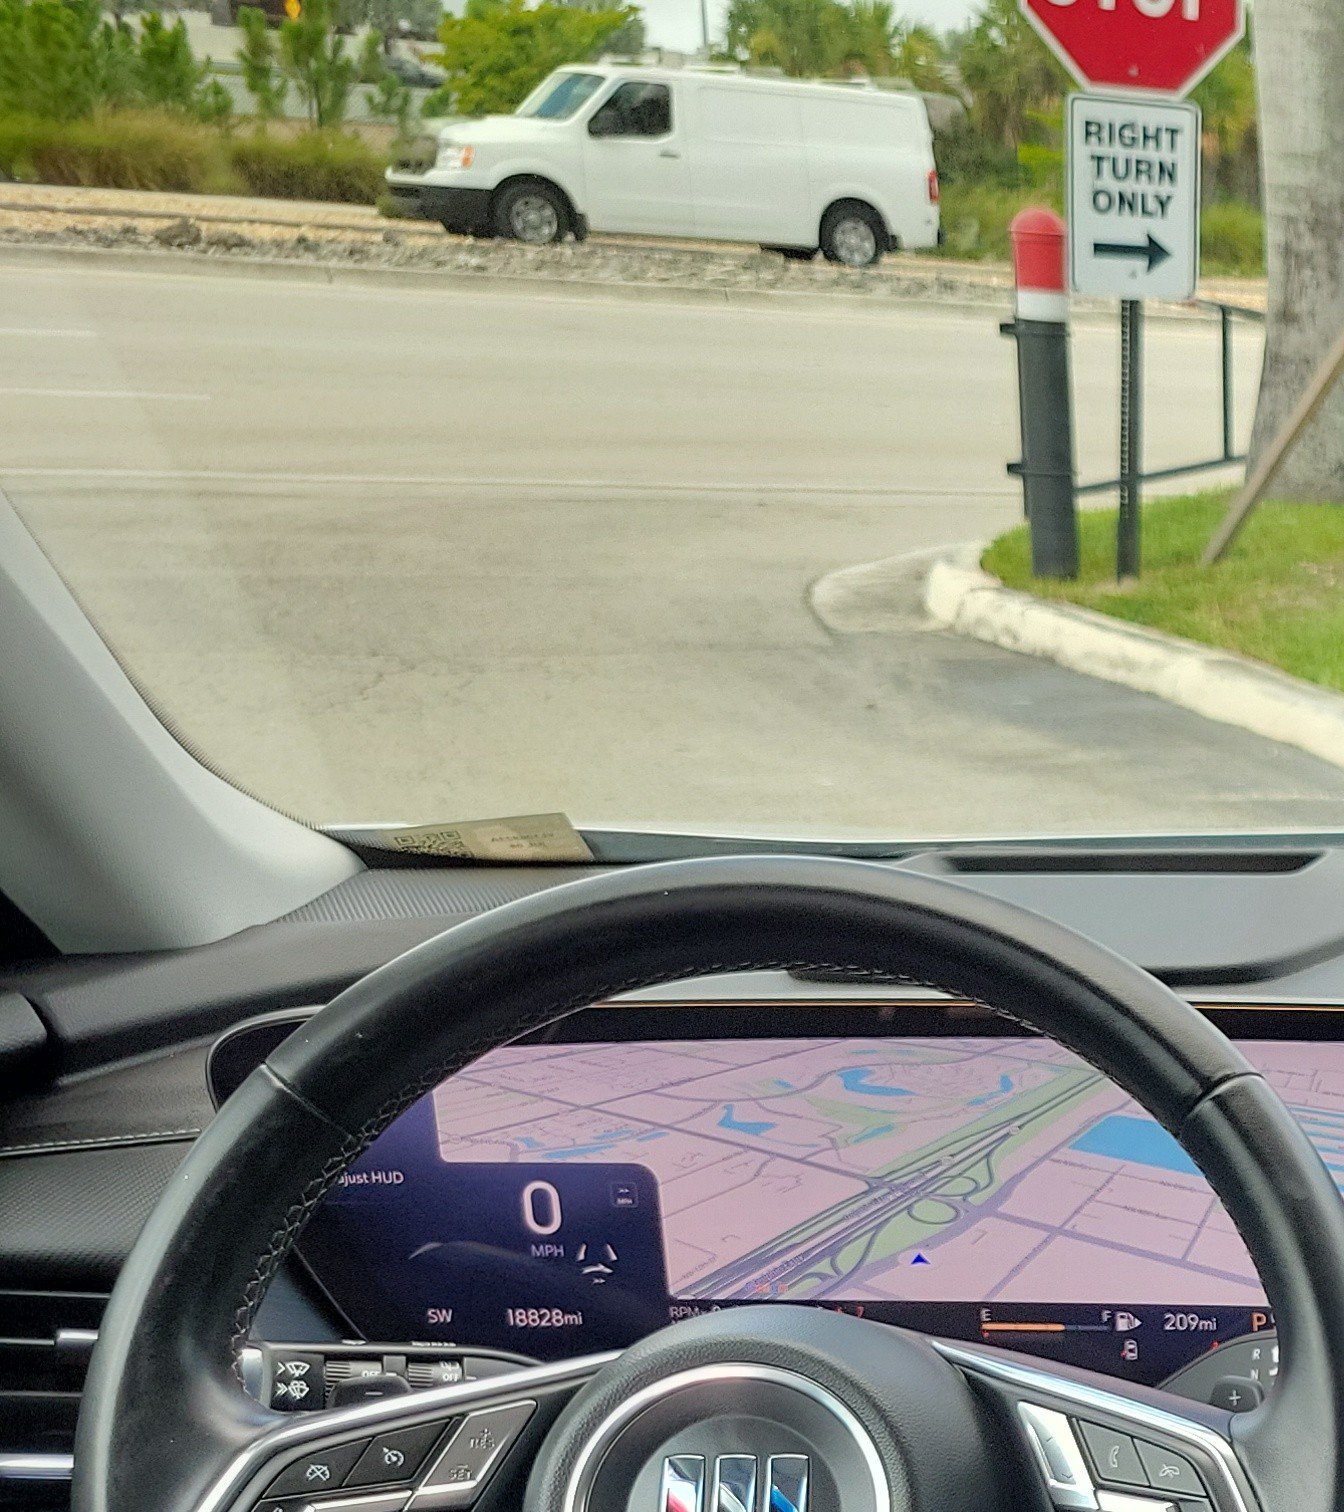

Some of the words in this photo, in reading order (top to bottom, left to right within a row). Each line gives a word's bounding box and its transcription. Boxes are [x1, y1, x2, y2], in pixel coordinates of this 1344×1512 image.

[1084, 120, 1183, 151] RIGHT
[1090, 154, 1177, 184] TURN
[1092, 189, 1174, 219] ONLY
[371, 1170, 404, 1184] HUD
[522, 1180, 563, 1235] 0
[530, 1245, 564, 1257] MPH
[427, 1308, 452, 1323] SW
[1163, 1313, 1217, 1331] 209mi
